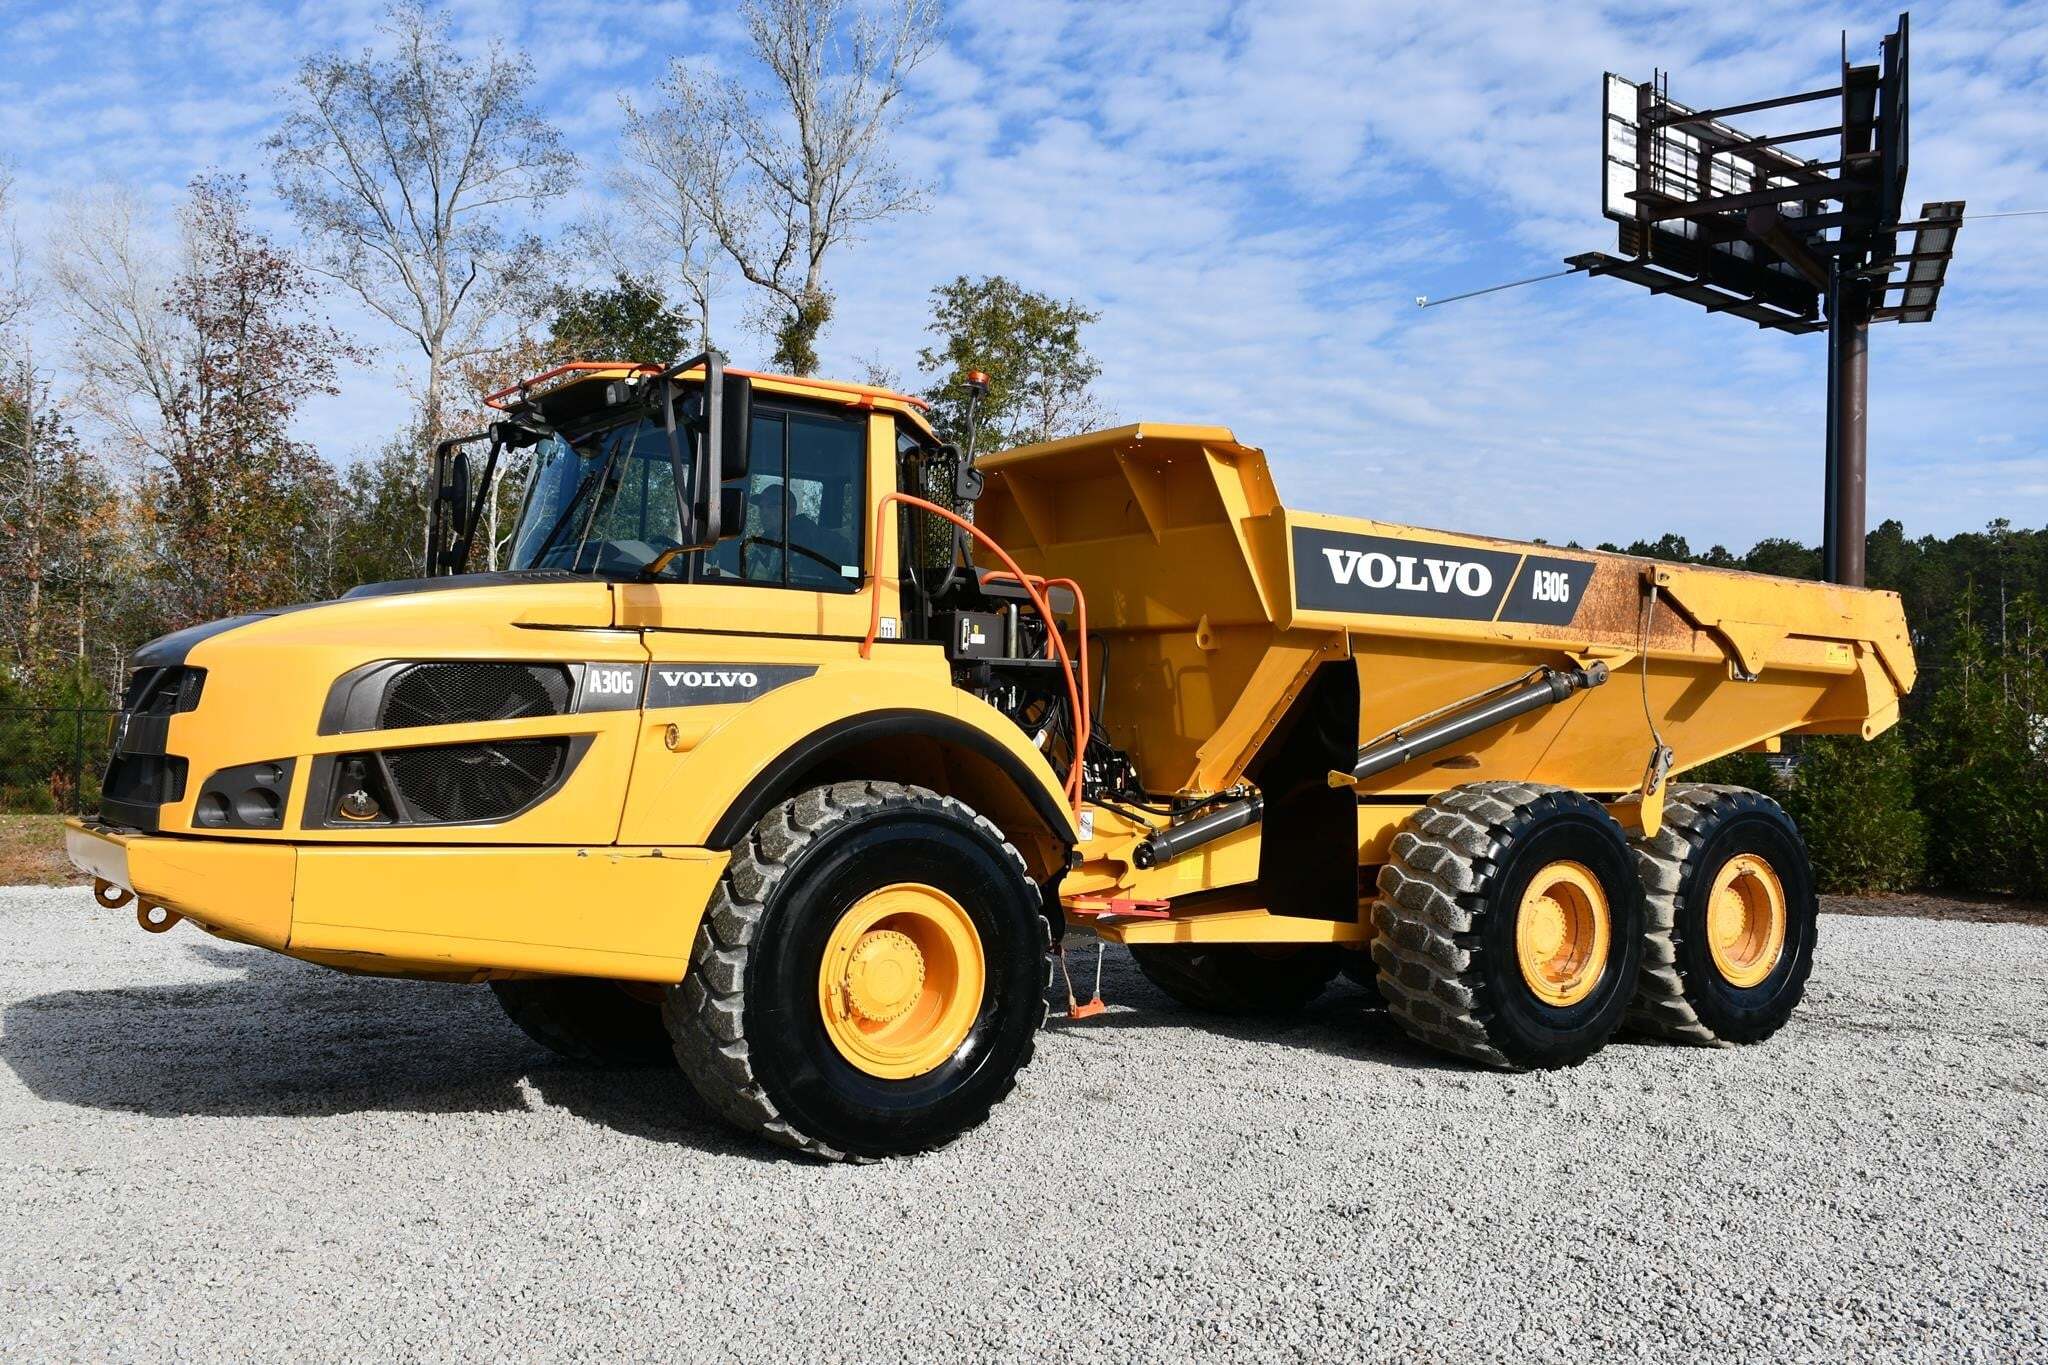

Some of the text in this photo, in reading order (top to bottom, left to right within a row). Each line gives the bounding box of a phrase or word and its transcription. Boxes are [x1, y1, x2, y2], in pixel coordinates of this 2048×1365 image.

[1322, 548, 1493, 597] VOLVO
[1532, 570, 1569, 602] A30G
[589, 670, 634, 694] A30G
[659, 671, 758, 687] VOLVO
